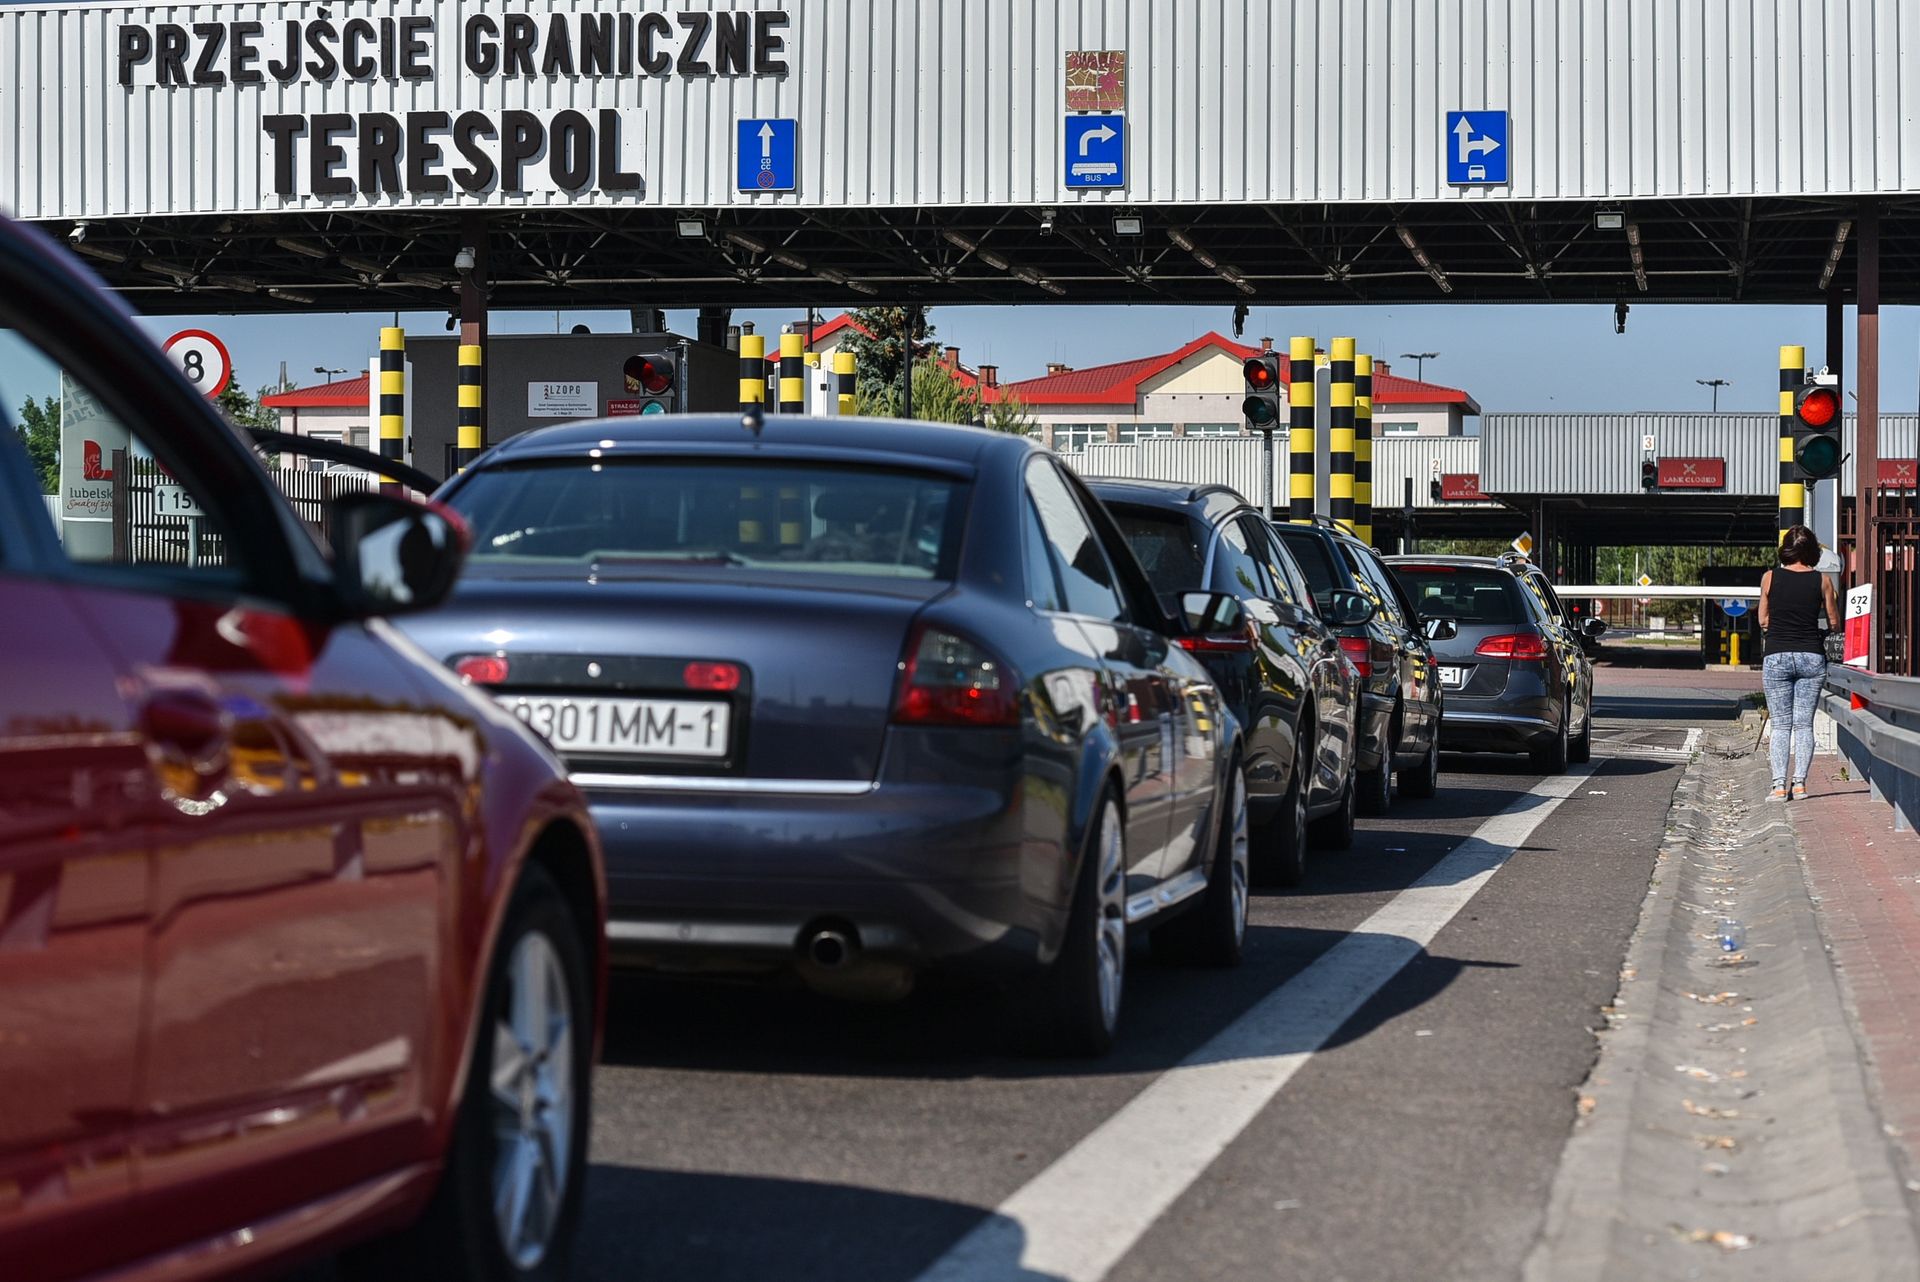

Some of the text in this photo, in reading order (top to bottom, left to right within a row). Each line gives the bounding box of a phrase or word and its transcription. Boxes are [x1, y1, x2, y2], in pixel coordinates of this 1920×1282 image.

[118, 7, 790, 86] PRZEJŚCIE GRANICZNE
[262, 108, 641, 195] TERESPOL
[1085, 174, 1102, 182] BUS
[183, 349, 205, 384] 8
[1645, 437, 1652, 449] 3
[1433, 460, 1439, 470] 2
[1851, 595, 1867, 605] 672
[1855, 605, 1862, 615] 3
